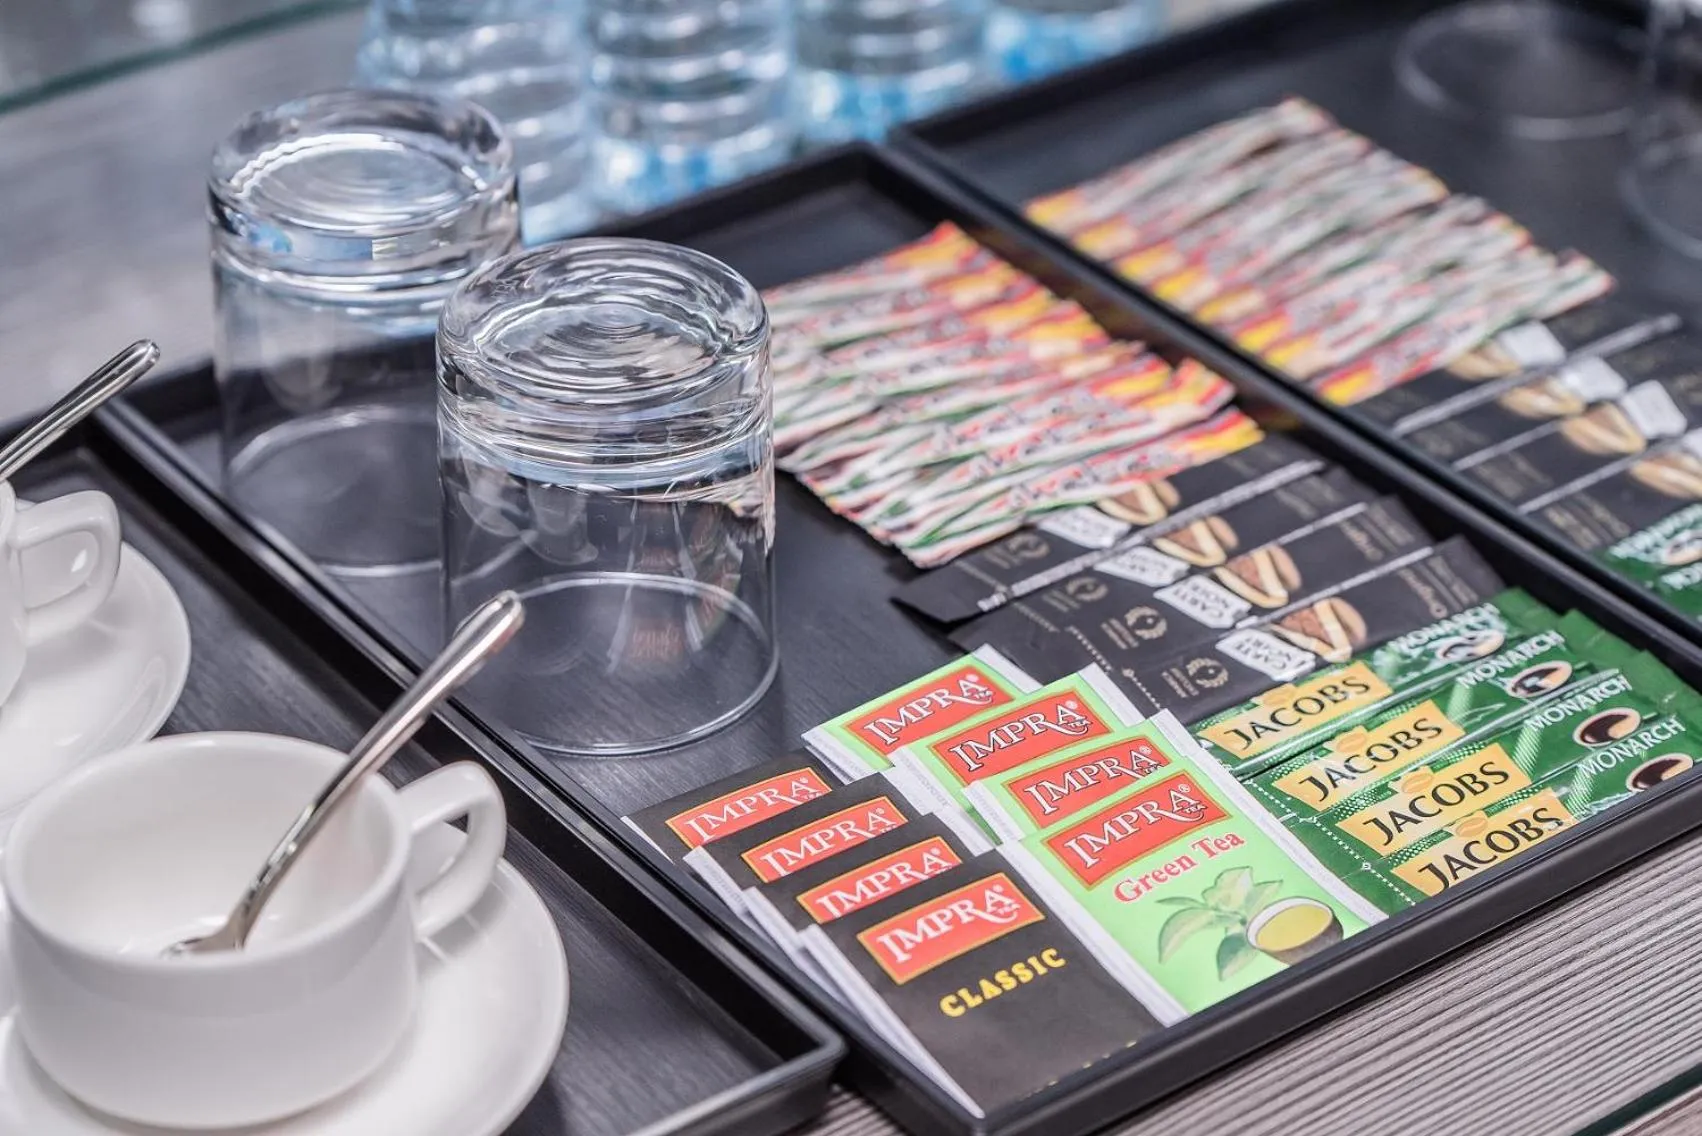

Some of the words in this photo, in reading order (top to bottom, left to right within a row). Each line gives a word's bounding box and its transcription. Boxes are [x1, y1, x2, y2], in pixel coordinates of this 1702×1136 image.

[1458, 629, 1565, 689] MONARCH
[863, 679, 993, 746] IMPRA
[949, 701, 1089, 772] IMPRA
[1223, 670, 1371, 750] JACOBS
[1529, 673, 1633, 731] MONARCH
[1298, 718, 1442, 802] JACOBS
[1579, 714, 1686, 778] MONARCH
[685, 779, 817, 842] IMPRA
[1024, 749, 1159, 815] IMPRA
[1362, 761, 1510, 846] JACOBS
[760, 811, 895, 877] IMPRA
[1064, 789, 1204, 869] IMPRA
[1418, 807, 1564, 894] JACOBS
[815, 852, 952, 918] IMPRA
[1113, 853, 1197, 903] Green
[1191, 832, 1245, 860] Tea
[876, 887, 1017, 963] IMPRA
[939, 948, 1066, 1017] CLASSIC
